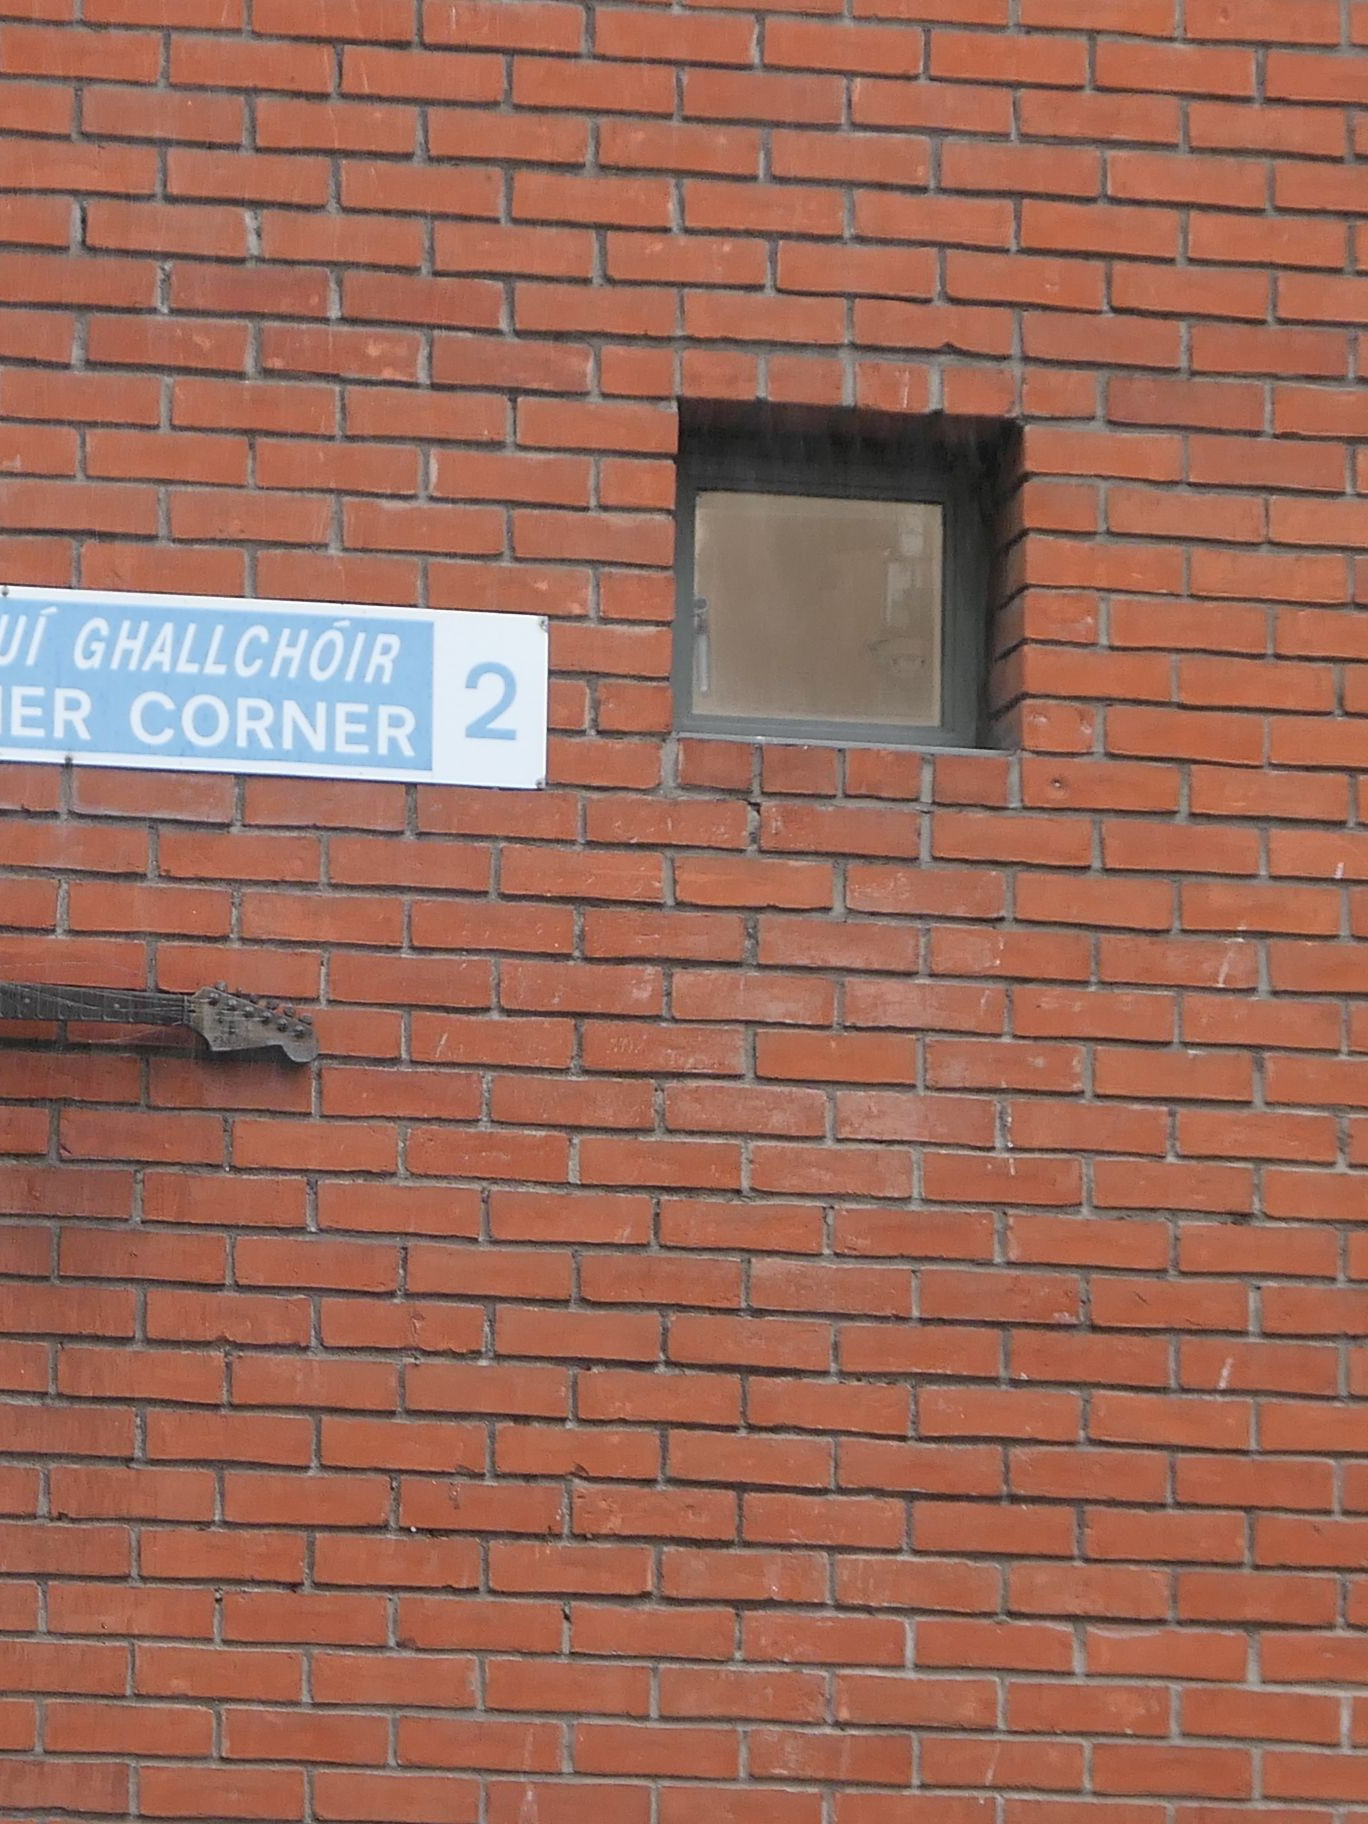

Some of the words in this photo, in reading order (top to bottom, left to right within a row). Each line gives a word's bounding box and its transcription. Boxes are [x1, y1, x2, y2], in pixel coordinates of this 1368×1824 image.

[73, 617, 400, 685] GHALLCHÓIR
[129, 690, 415, 758] CORNER
[464, 662, 518, 741] 2
